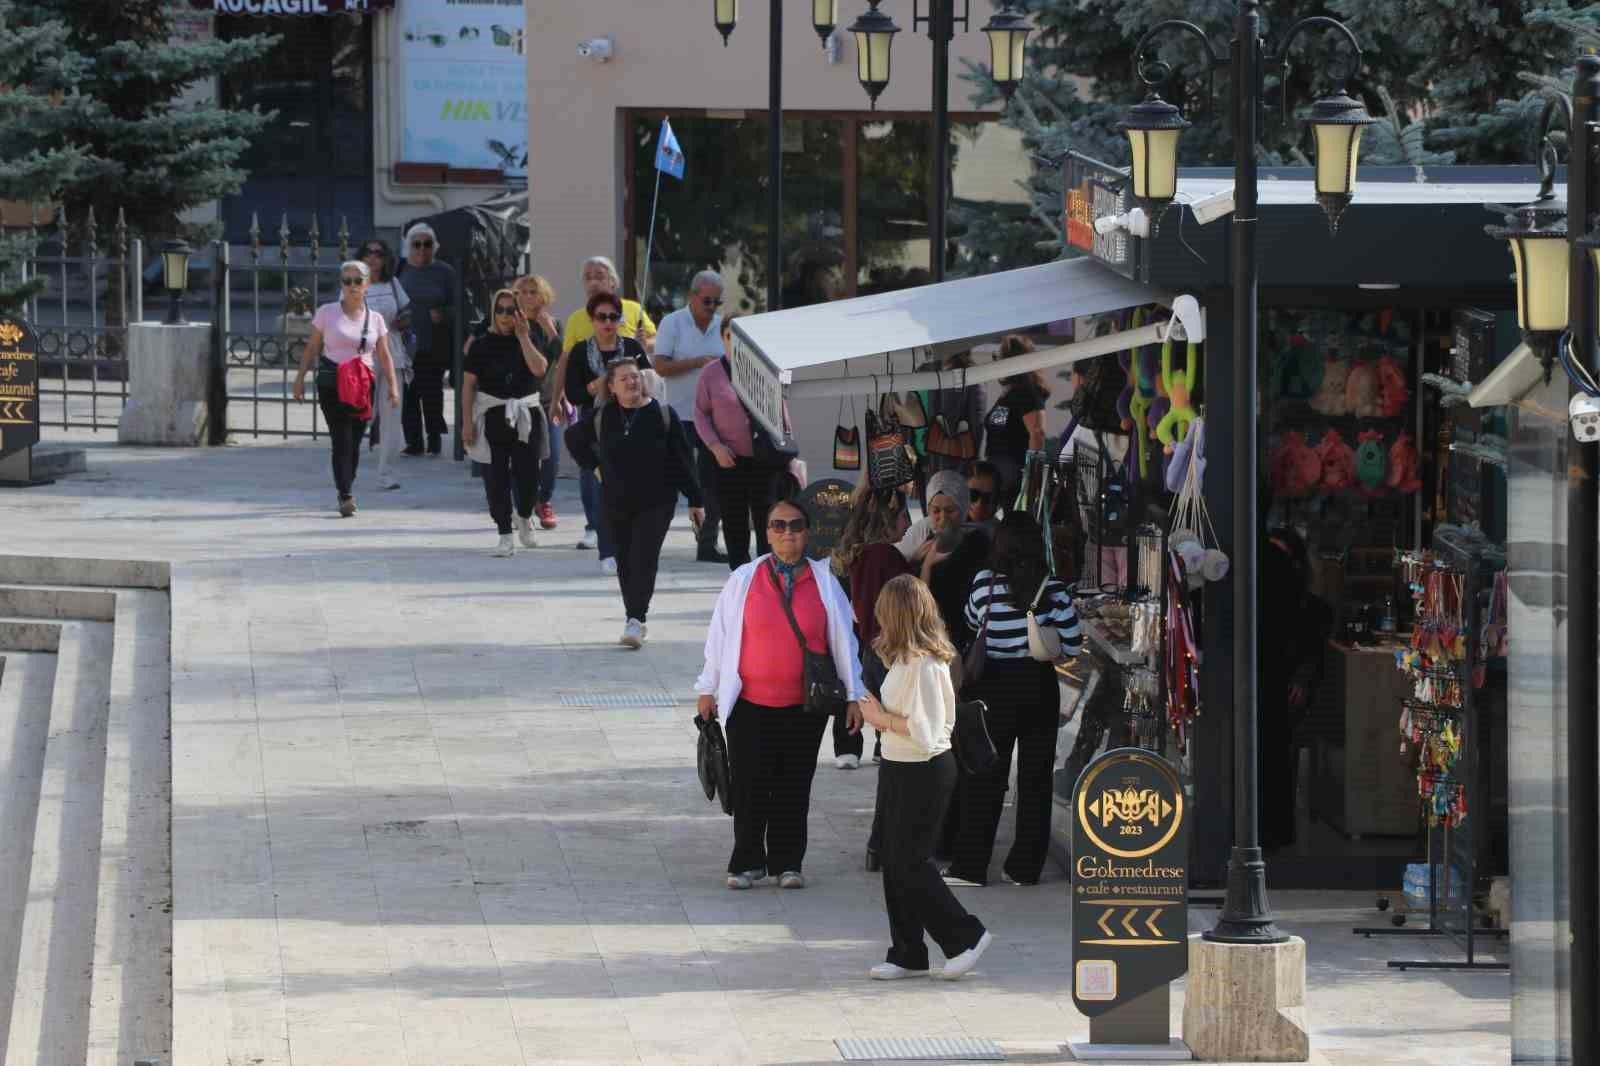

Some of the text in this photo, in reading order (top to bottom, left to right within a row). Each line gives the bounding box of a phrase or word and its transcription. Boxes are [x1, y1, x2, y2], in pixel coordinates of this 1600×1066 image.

[1119, 826, 1143, 835] 2023
[1086, 880, 1184, 896] cafe restaurant
